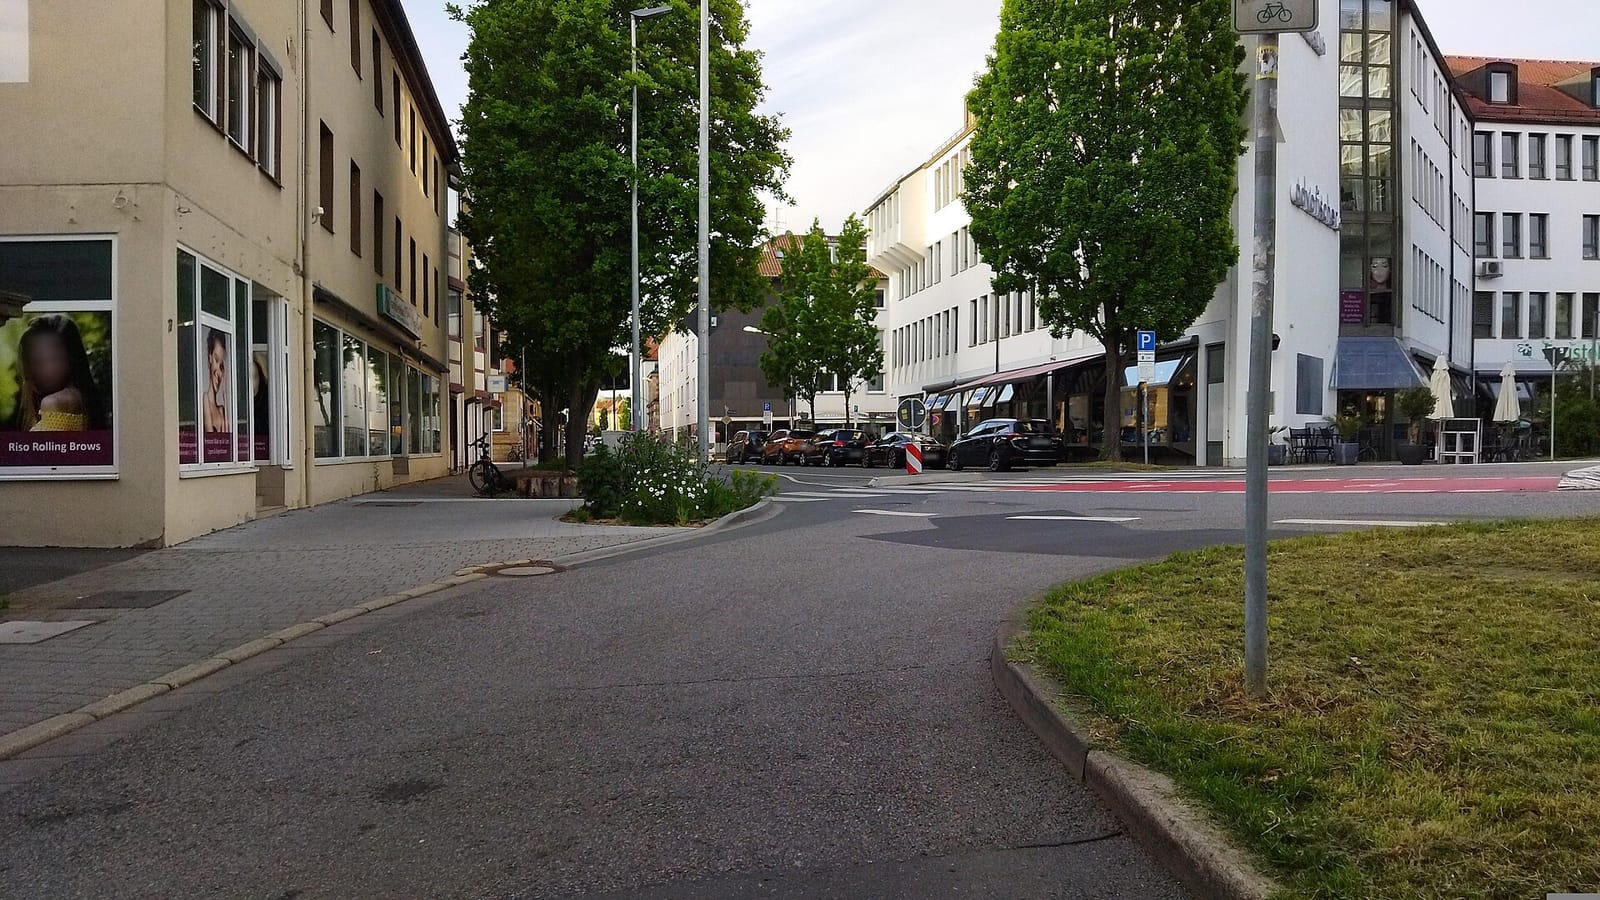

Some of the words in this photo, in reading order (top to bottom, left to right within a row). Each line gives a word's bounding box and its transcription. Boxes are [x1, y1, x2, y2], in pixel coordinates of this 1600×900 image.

[1141, 333, 1151, 349] P
[8, 442, 30, 451] Riso
[32, 442, 67, 453] Rolling
[69, 441, 101, 451] Brows
